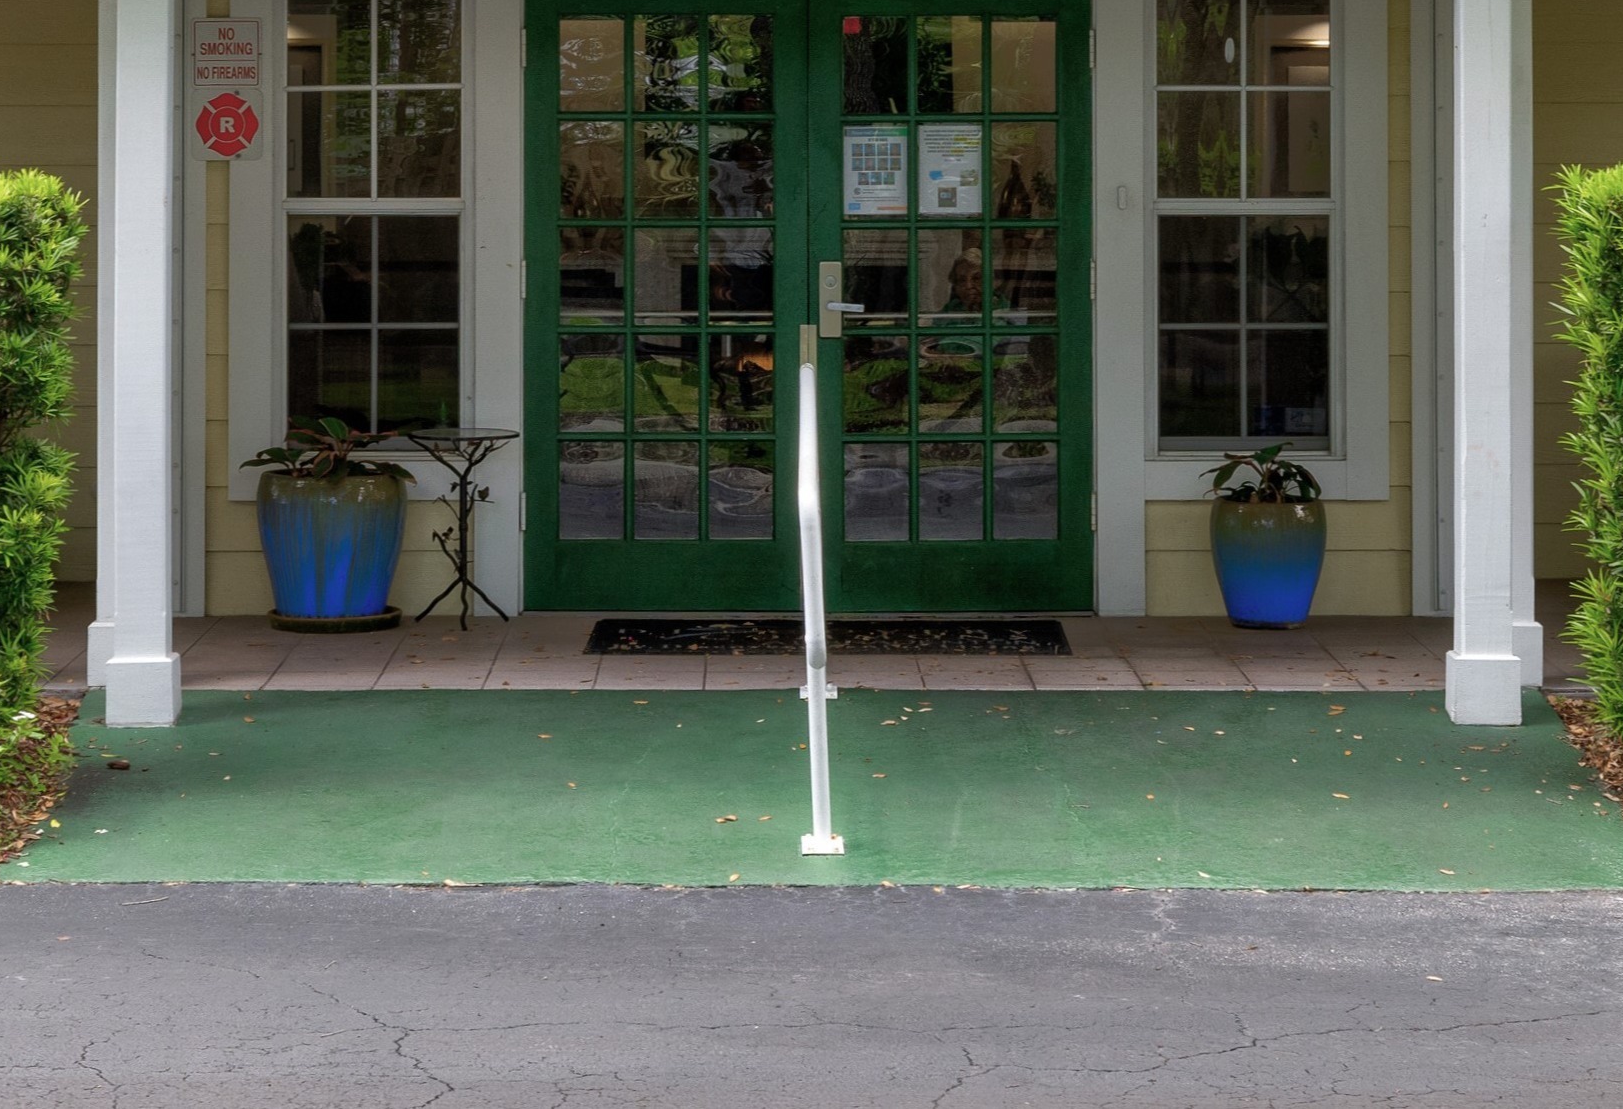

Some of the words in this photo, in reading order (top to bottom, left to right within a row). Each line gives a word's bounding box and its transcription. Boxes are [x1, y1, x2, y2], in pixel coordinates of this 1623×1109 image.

[218, 27, 235, 41] NO
[200, 42, 253, 56] SMOKING
[196, 66, 210, 80] NO
[211, 66, 256, 80] FIREARMS
[219, 117, 235, 133] R
